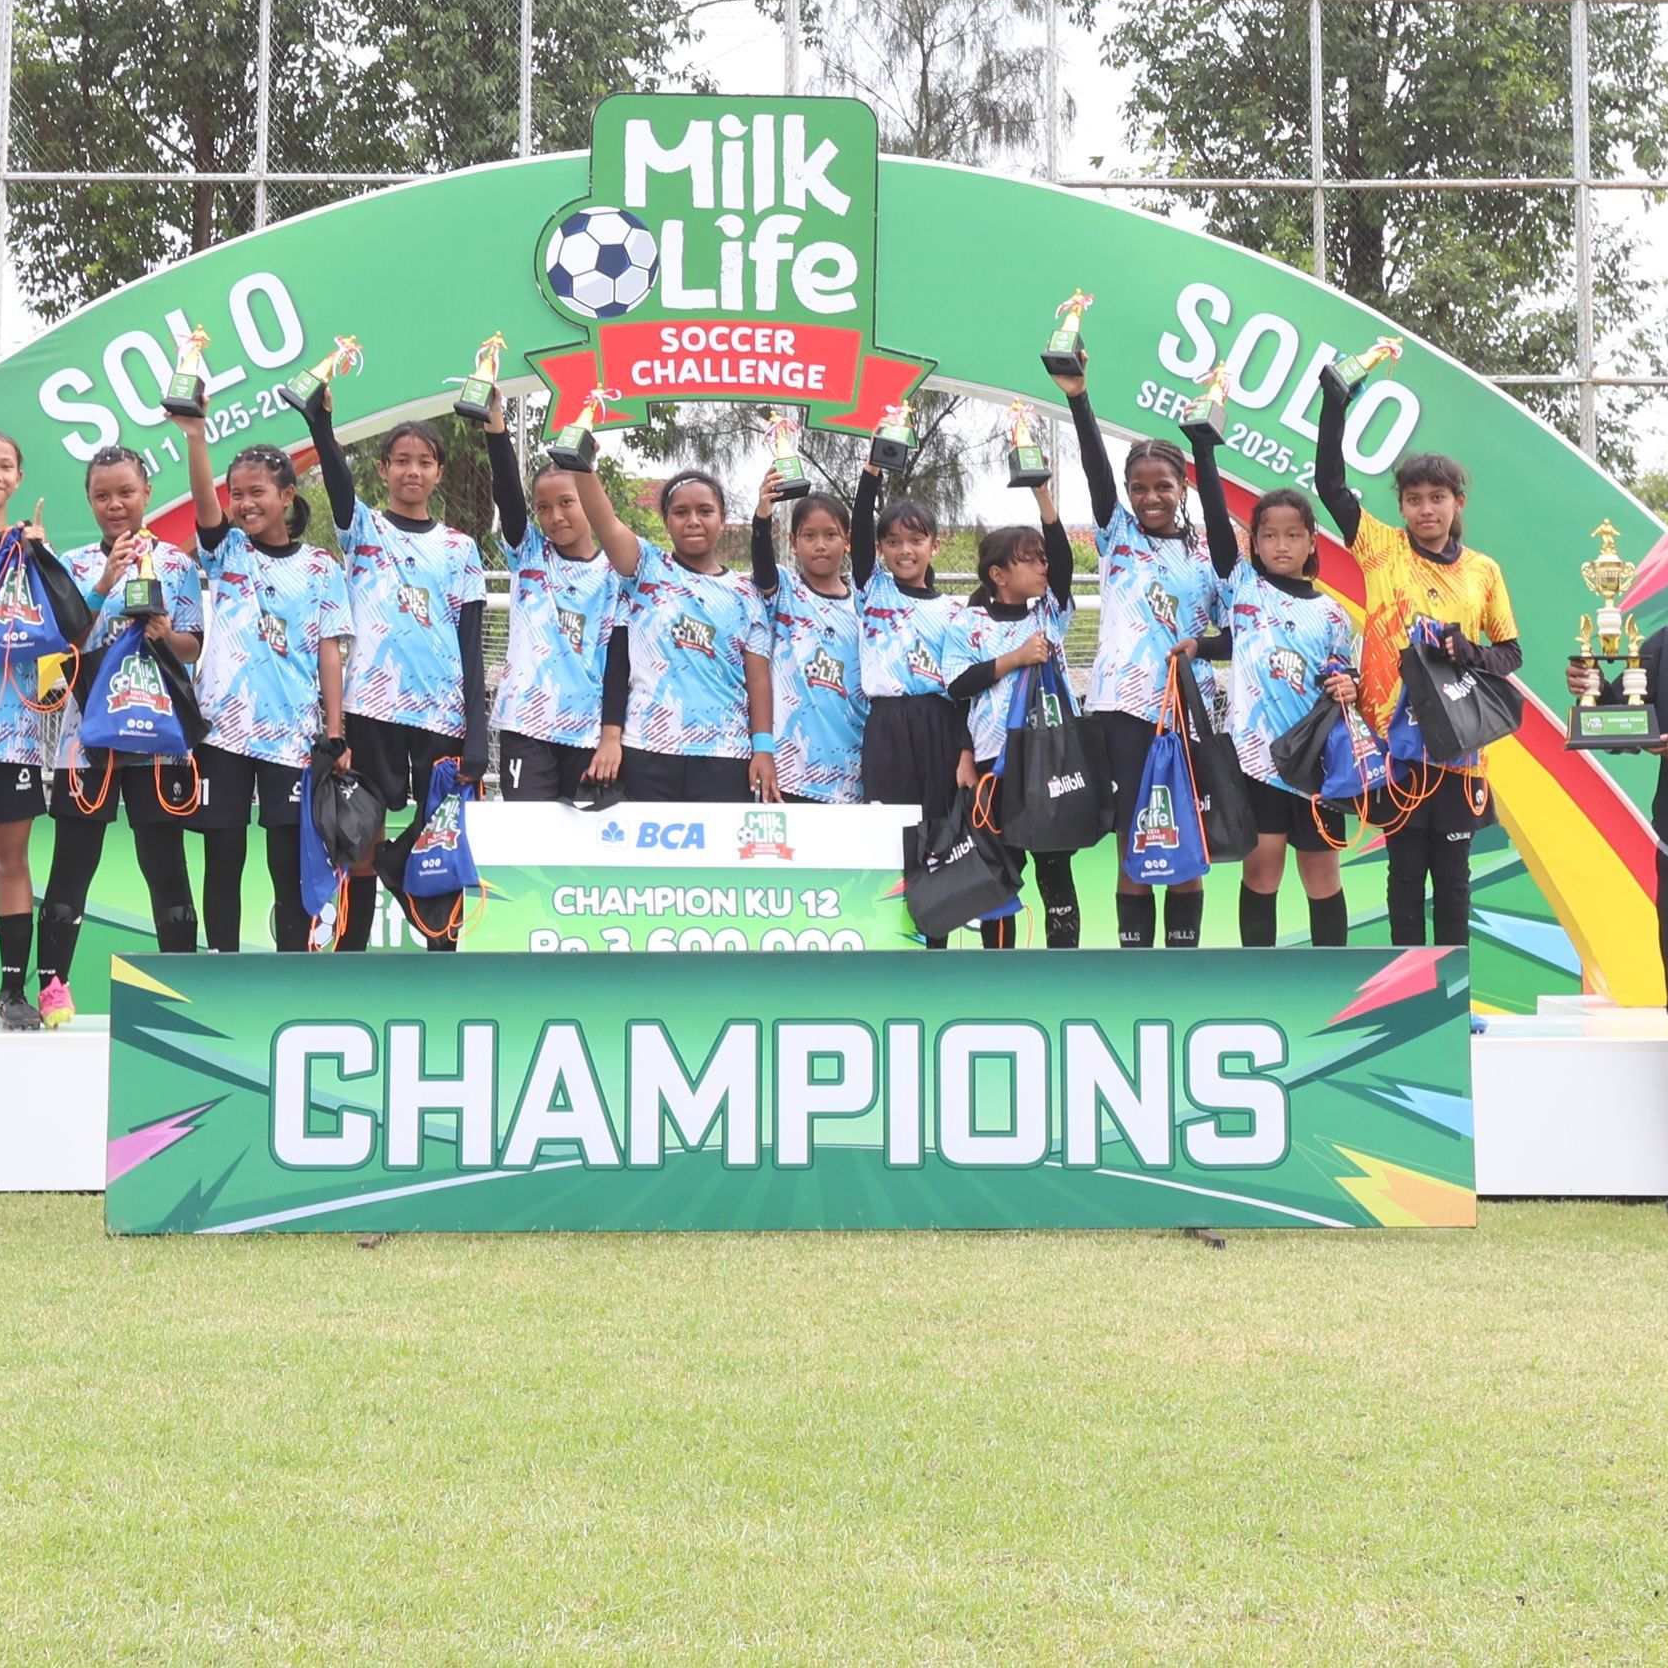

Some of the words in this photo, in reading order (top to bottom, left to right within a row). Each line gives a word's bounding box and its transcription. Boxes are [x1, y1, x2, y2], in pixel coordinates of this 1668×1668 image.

[625, 114, 851, 216] Milk
[660, 214, 858, 313] Life
[660, 326, 795, 356] SOCCER
[38, 272, 304, 461] SOLO
[632, 359, 826, 390] CHALLENGE
[1158, 282, 1420, 475] SOLO
[636, 822, 705, 850] BCA
[749, 813, 782, 830] Milk
[753, 827, 785, 844] Life
[553, 886, 737, 917] CHAMPION
[744, 887, 792, 918] KU
[801, 888, 840, 918] 12
[269, 1017, 1292, 1173] CHAMPIONS
